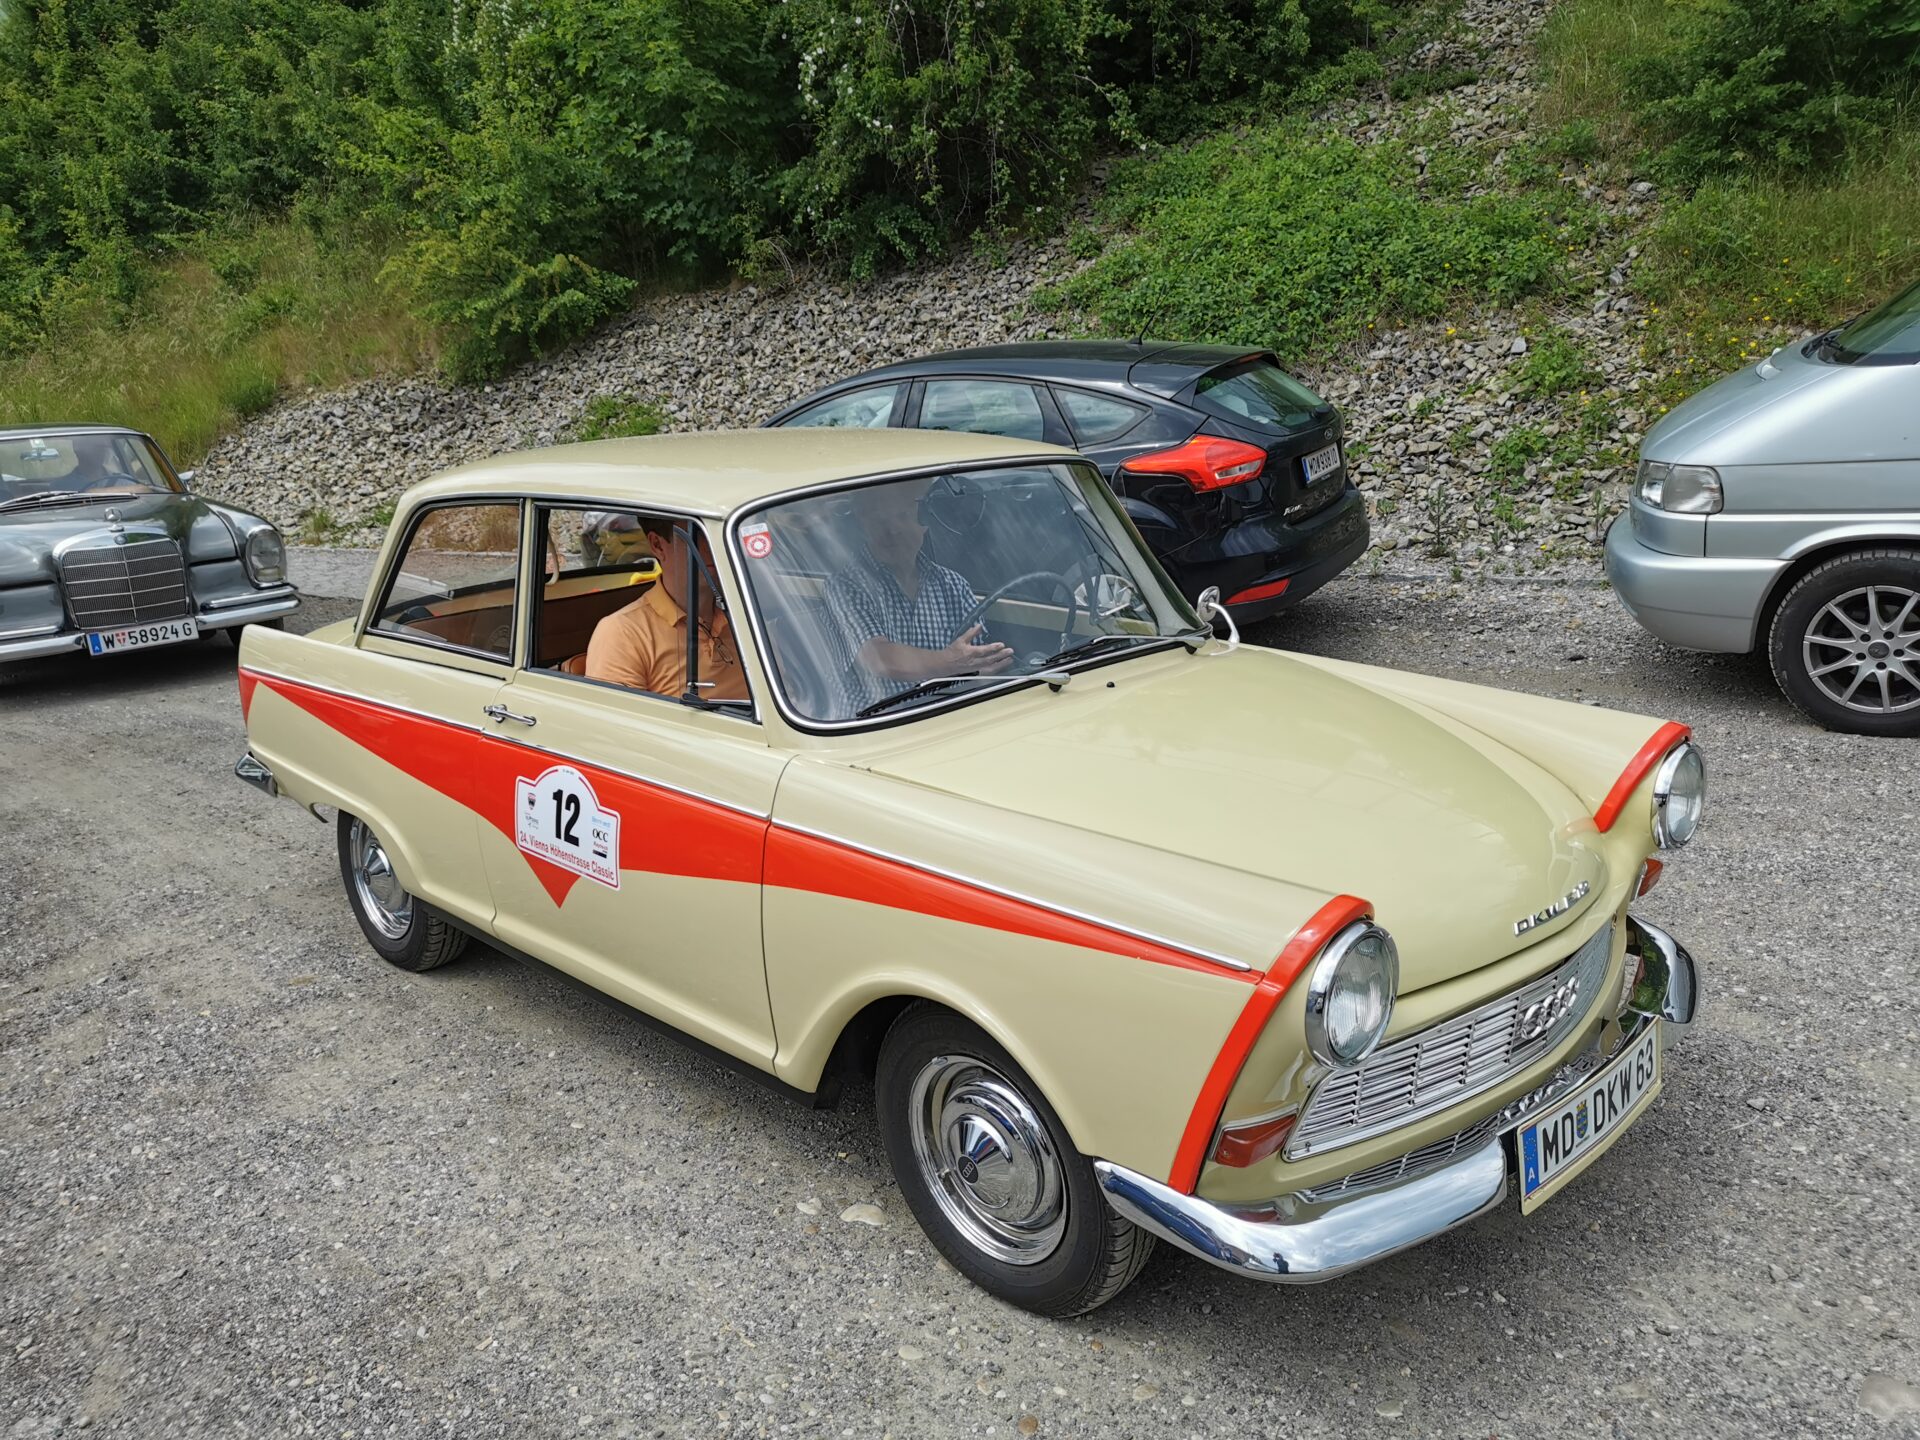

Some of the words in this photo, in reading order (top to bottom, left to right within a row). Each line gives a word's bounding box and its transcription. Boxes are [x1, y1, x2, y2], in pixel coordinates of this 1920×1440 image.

[102, 633, 115, 649] W
[128, 624, 179, 645] 58924
[182, 622, 192, 637] G
[552, 788, 581, 847] 12
[592, 828, 608, 843] OCC
[529, 834, 549, 853] Vienna
[591, 860, 614, 881] Classic
[1513, 900, 1560, 936] DKW
[1541, 1111, 1575, 1173] MD
[1593, 1060, 1632, 1134] DKW
[1636, 1038, 1653, 1092] 63
[1527, 1167, 1536, 1182] A
